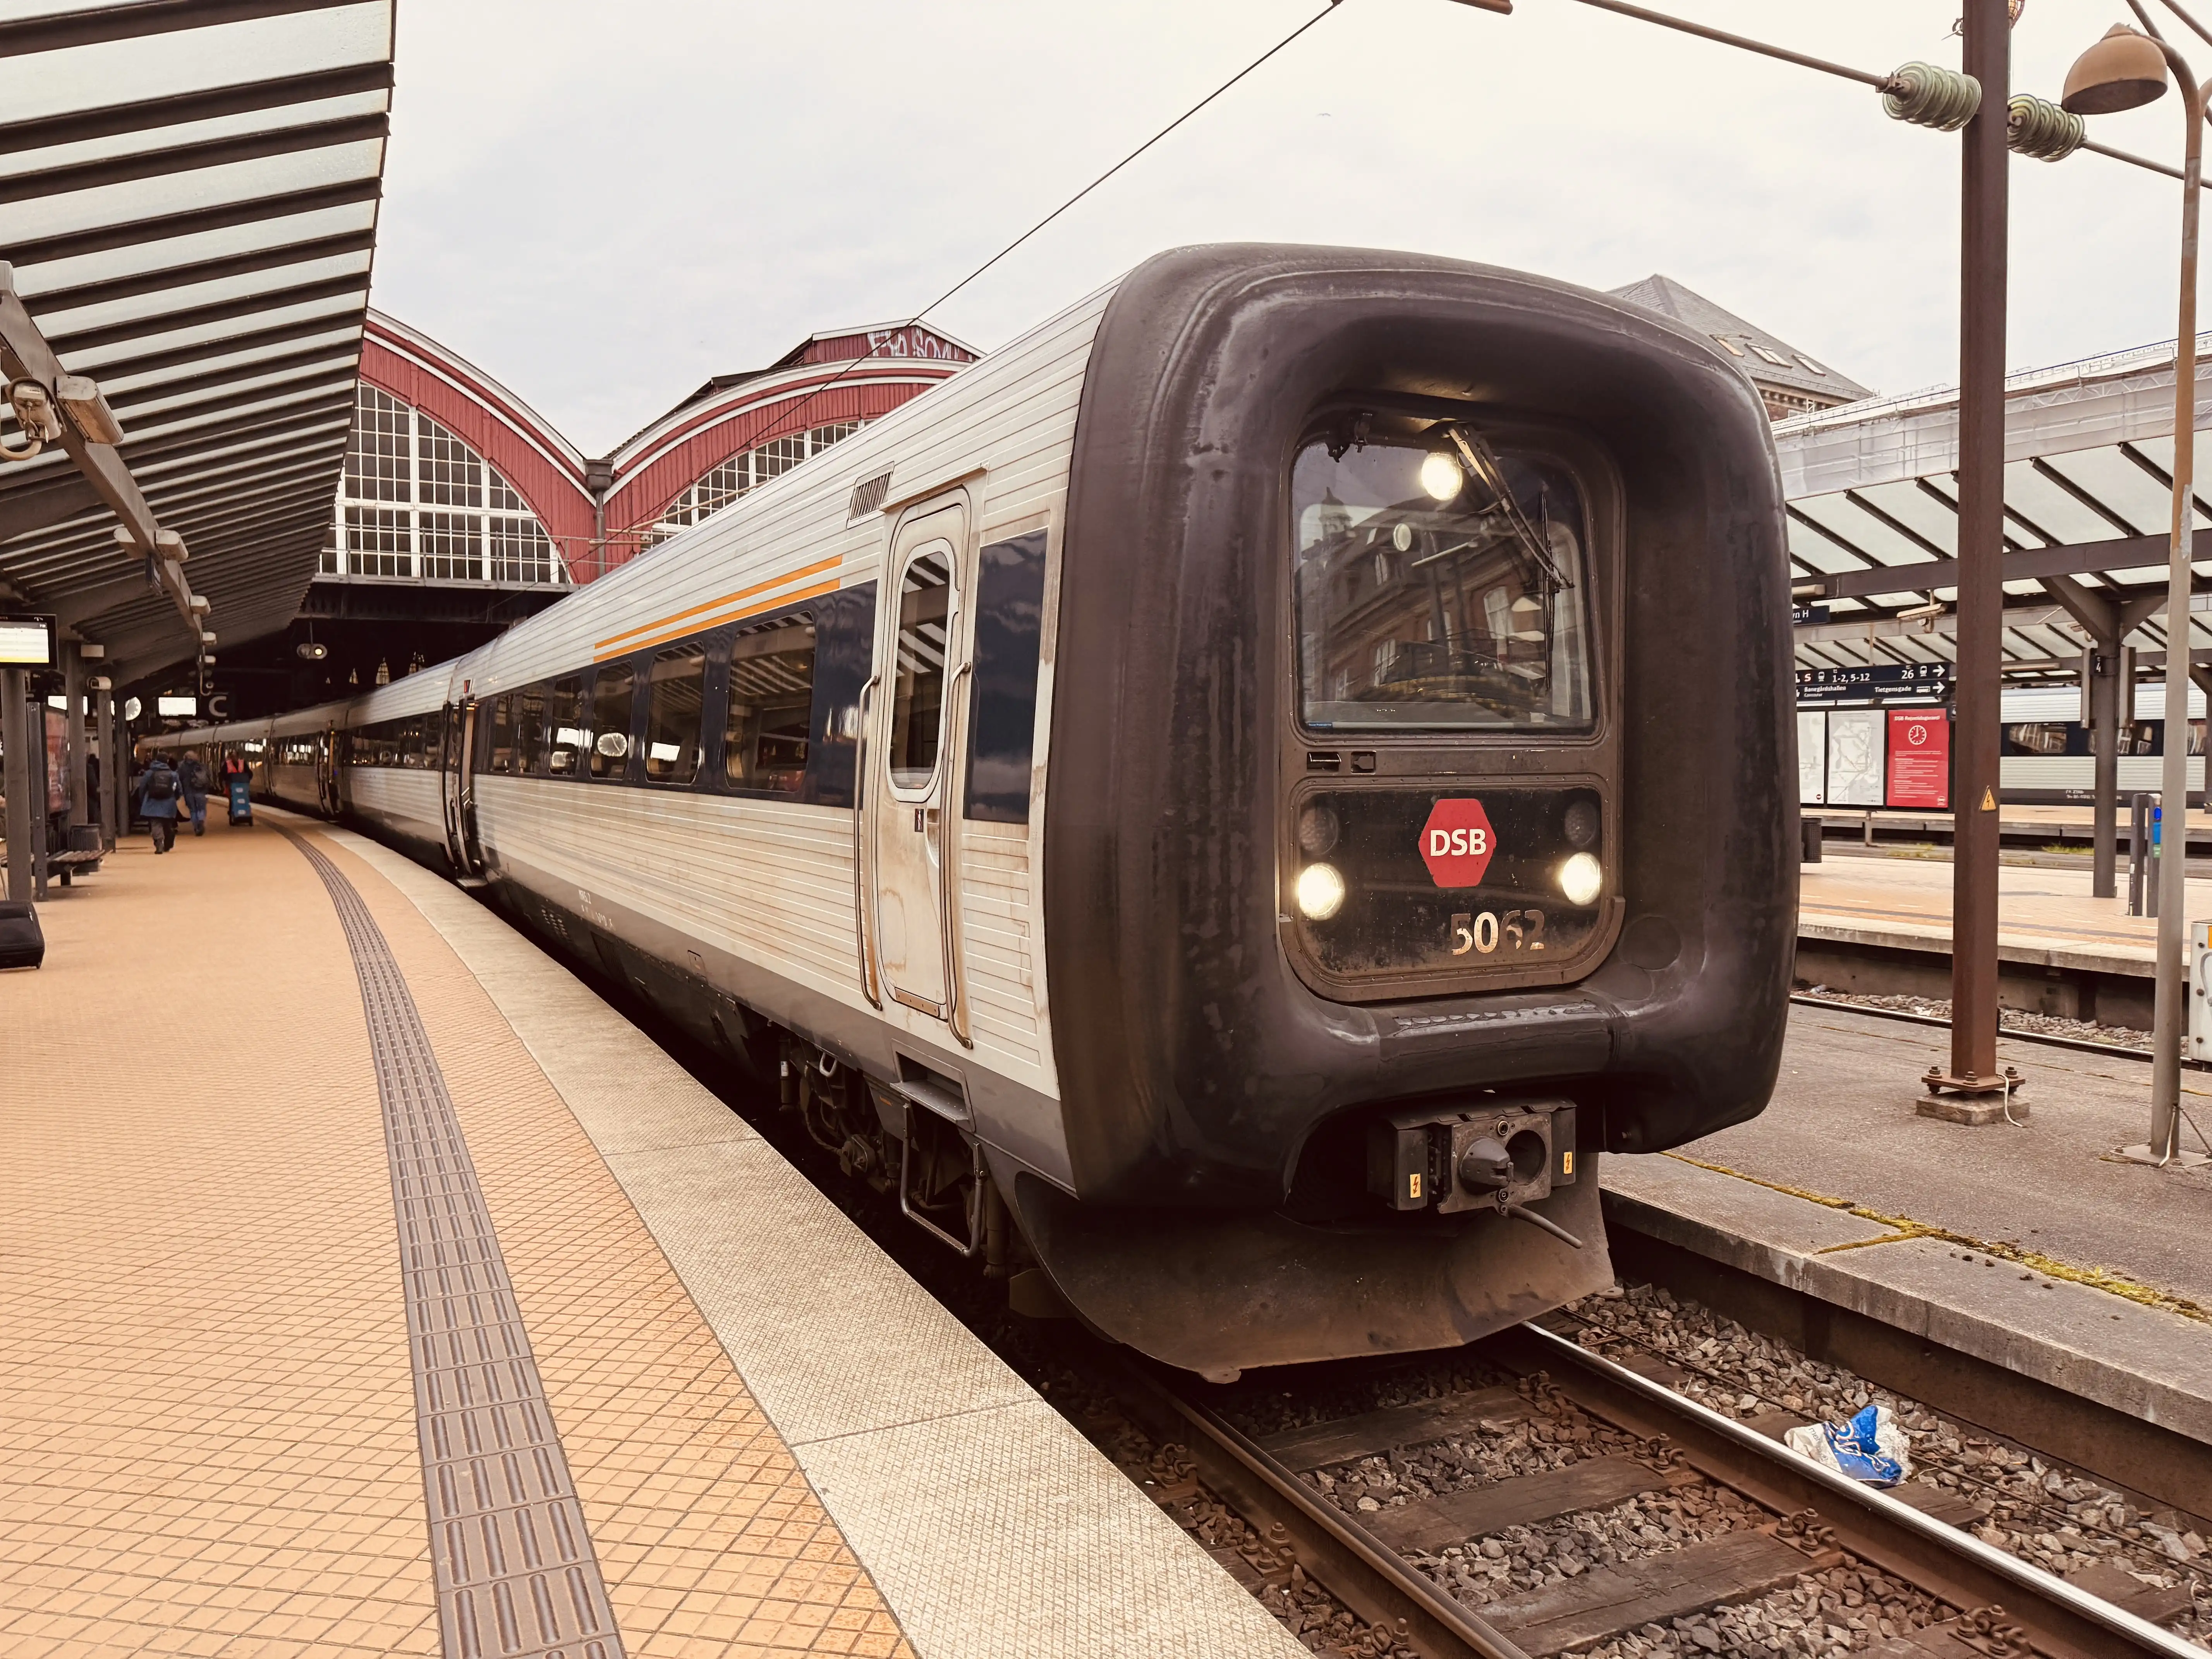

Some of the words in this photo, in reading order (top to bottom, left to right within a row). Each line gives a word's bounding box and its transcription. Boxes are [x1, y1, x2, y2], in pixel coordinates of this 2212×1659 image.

[1802, 609, 1809, 618] H
[1804, 673, 1811, 682] S
[1832, 674, 1848, 684] 1-2,
[1850, 673, 1870, 682] 5-12
[1901, 670, 1914, 679] 26
[209, 696, 227, 716] C
[1431, 829, 1486, 856] DSB
[1451, 910, 1544, 955] 5062
